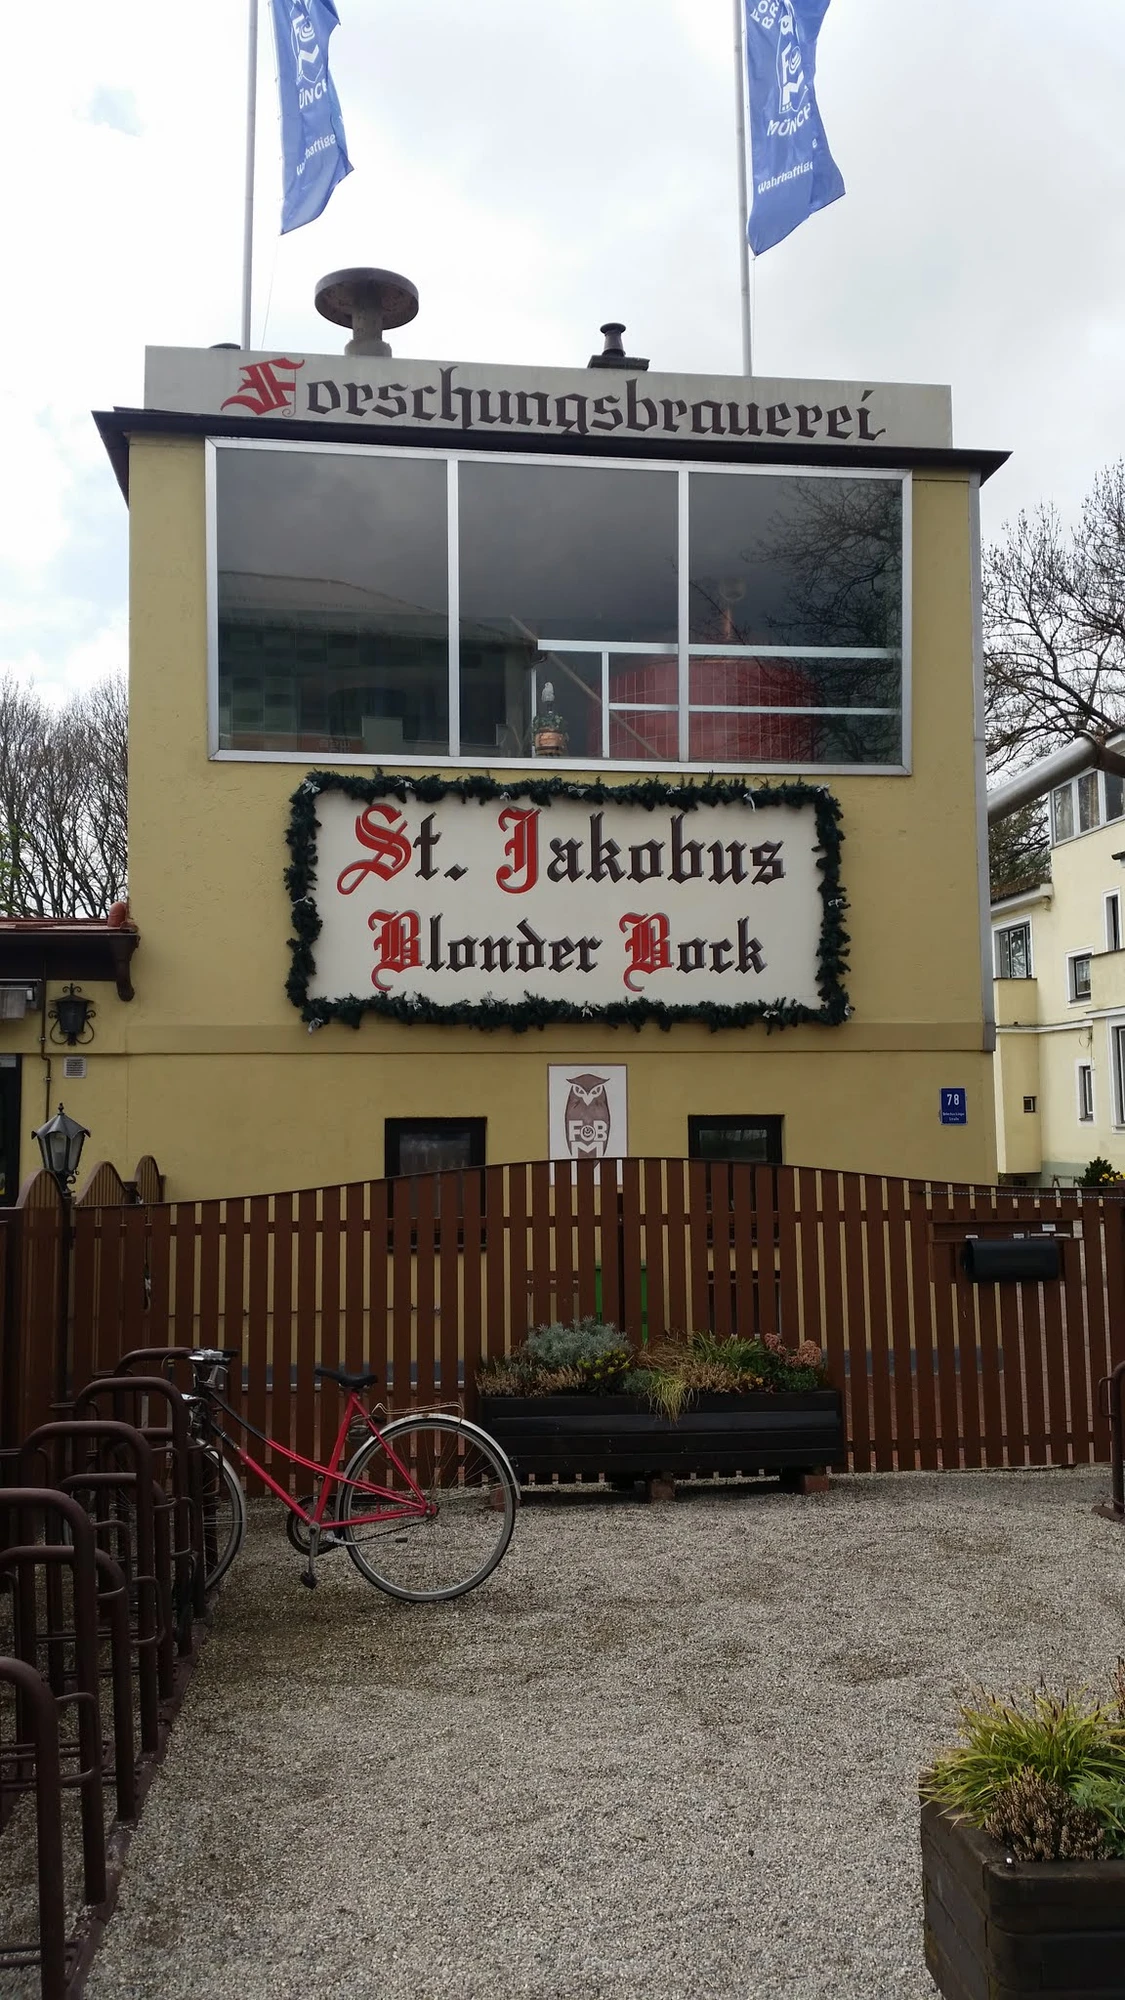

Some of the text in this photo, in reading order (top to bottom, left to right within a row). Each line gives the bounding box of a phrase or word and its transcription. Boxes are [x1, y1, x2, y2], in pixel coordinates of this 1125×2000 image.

[220, 357, 887, 441] Forschungsbrauerei
[337, 803, 787, 895] St. Jakobus
[368, 909, 769, 992] Blonder Bock
[946, 1093, 960, 1106] 78
